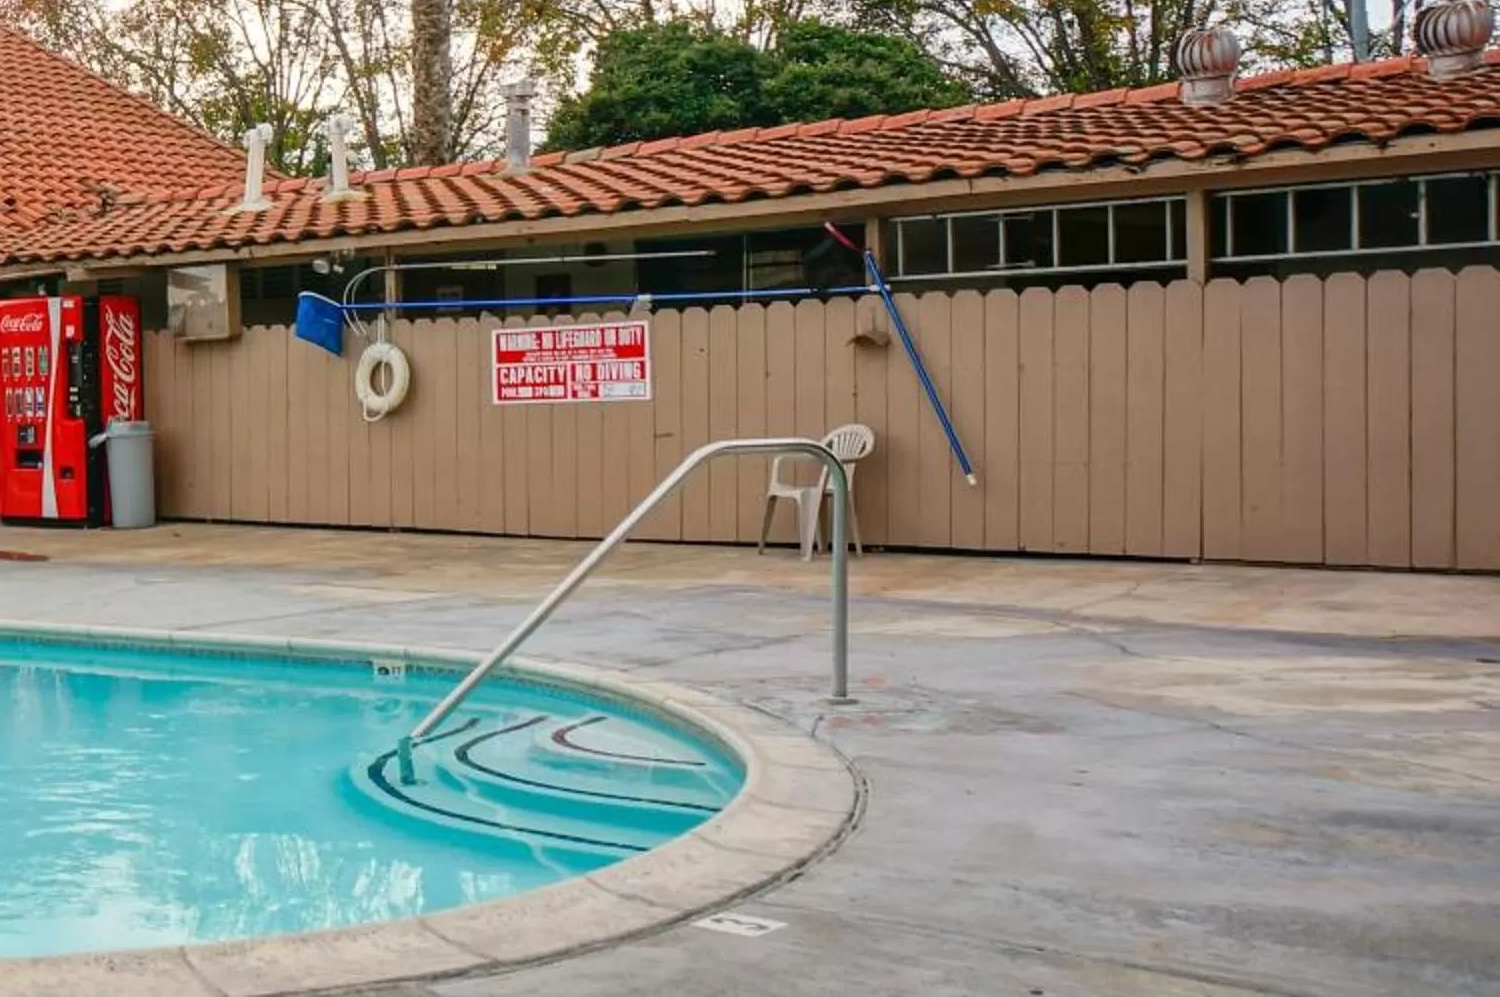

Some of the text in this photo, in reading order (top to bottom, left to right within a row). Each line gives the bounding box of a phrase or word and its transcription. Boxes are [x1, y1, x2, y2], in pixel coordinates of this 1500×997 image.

[0, 313, 44, 334] Coca-Cola
[618, 325, 643, 346] DUTY
[501, 366, 566, 385] CAPACITY
[575, 361, 642, 382] NO DIVING
